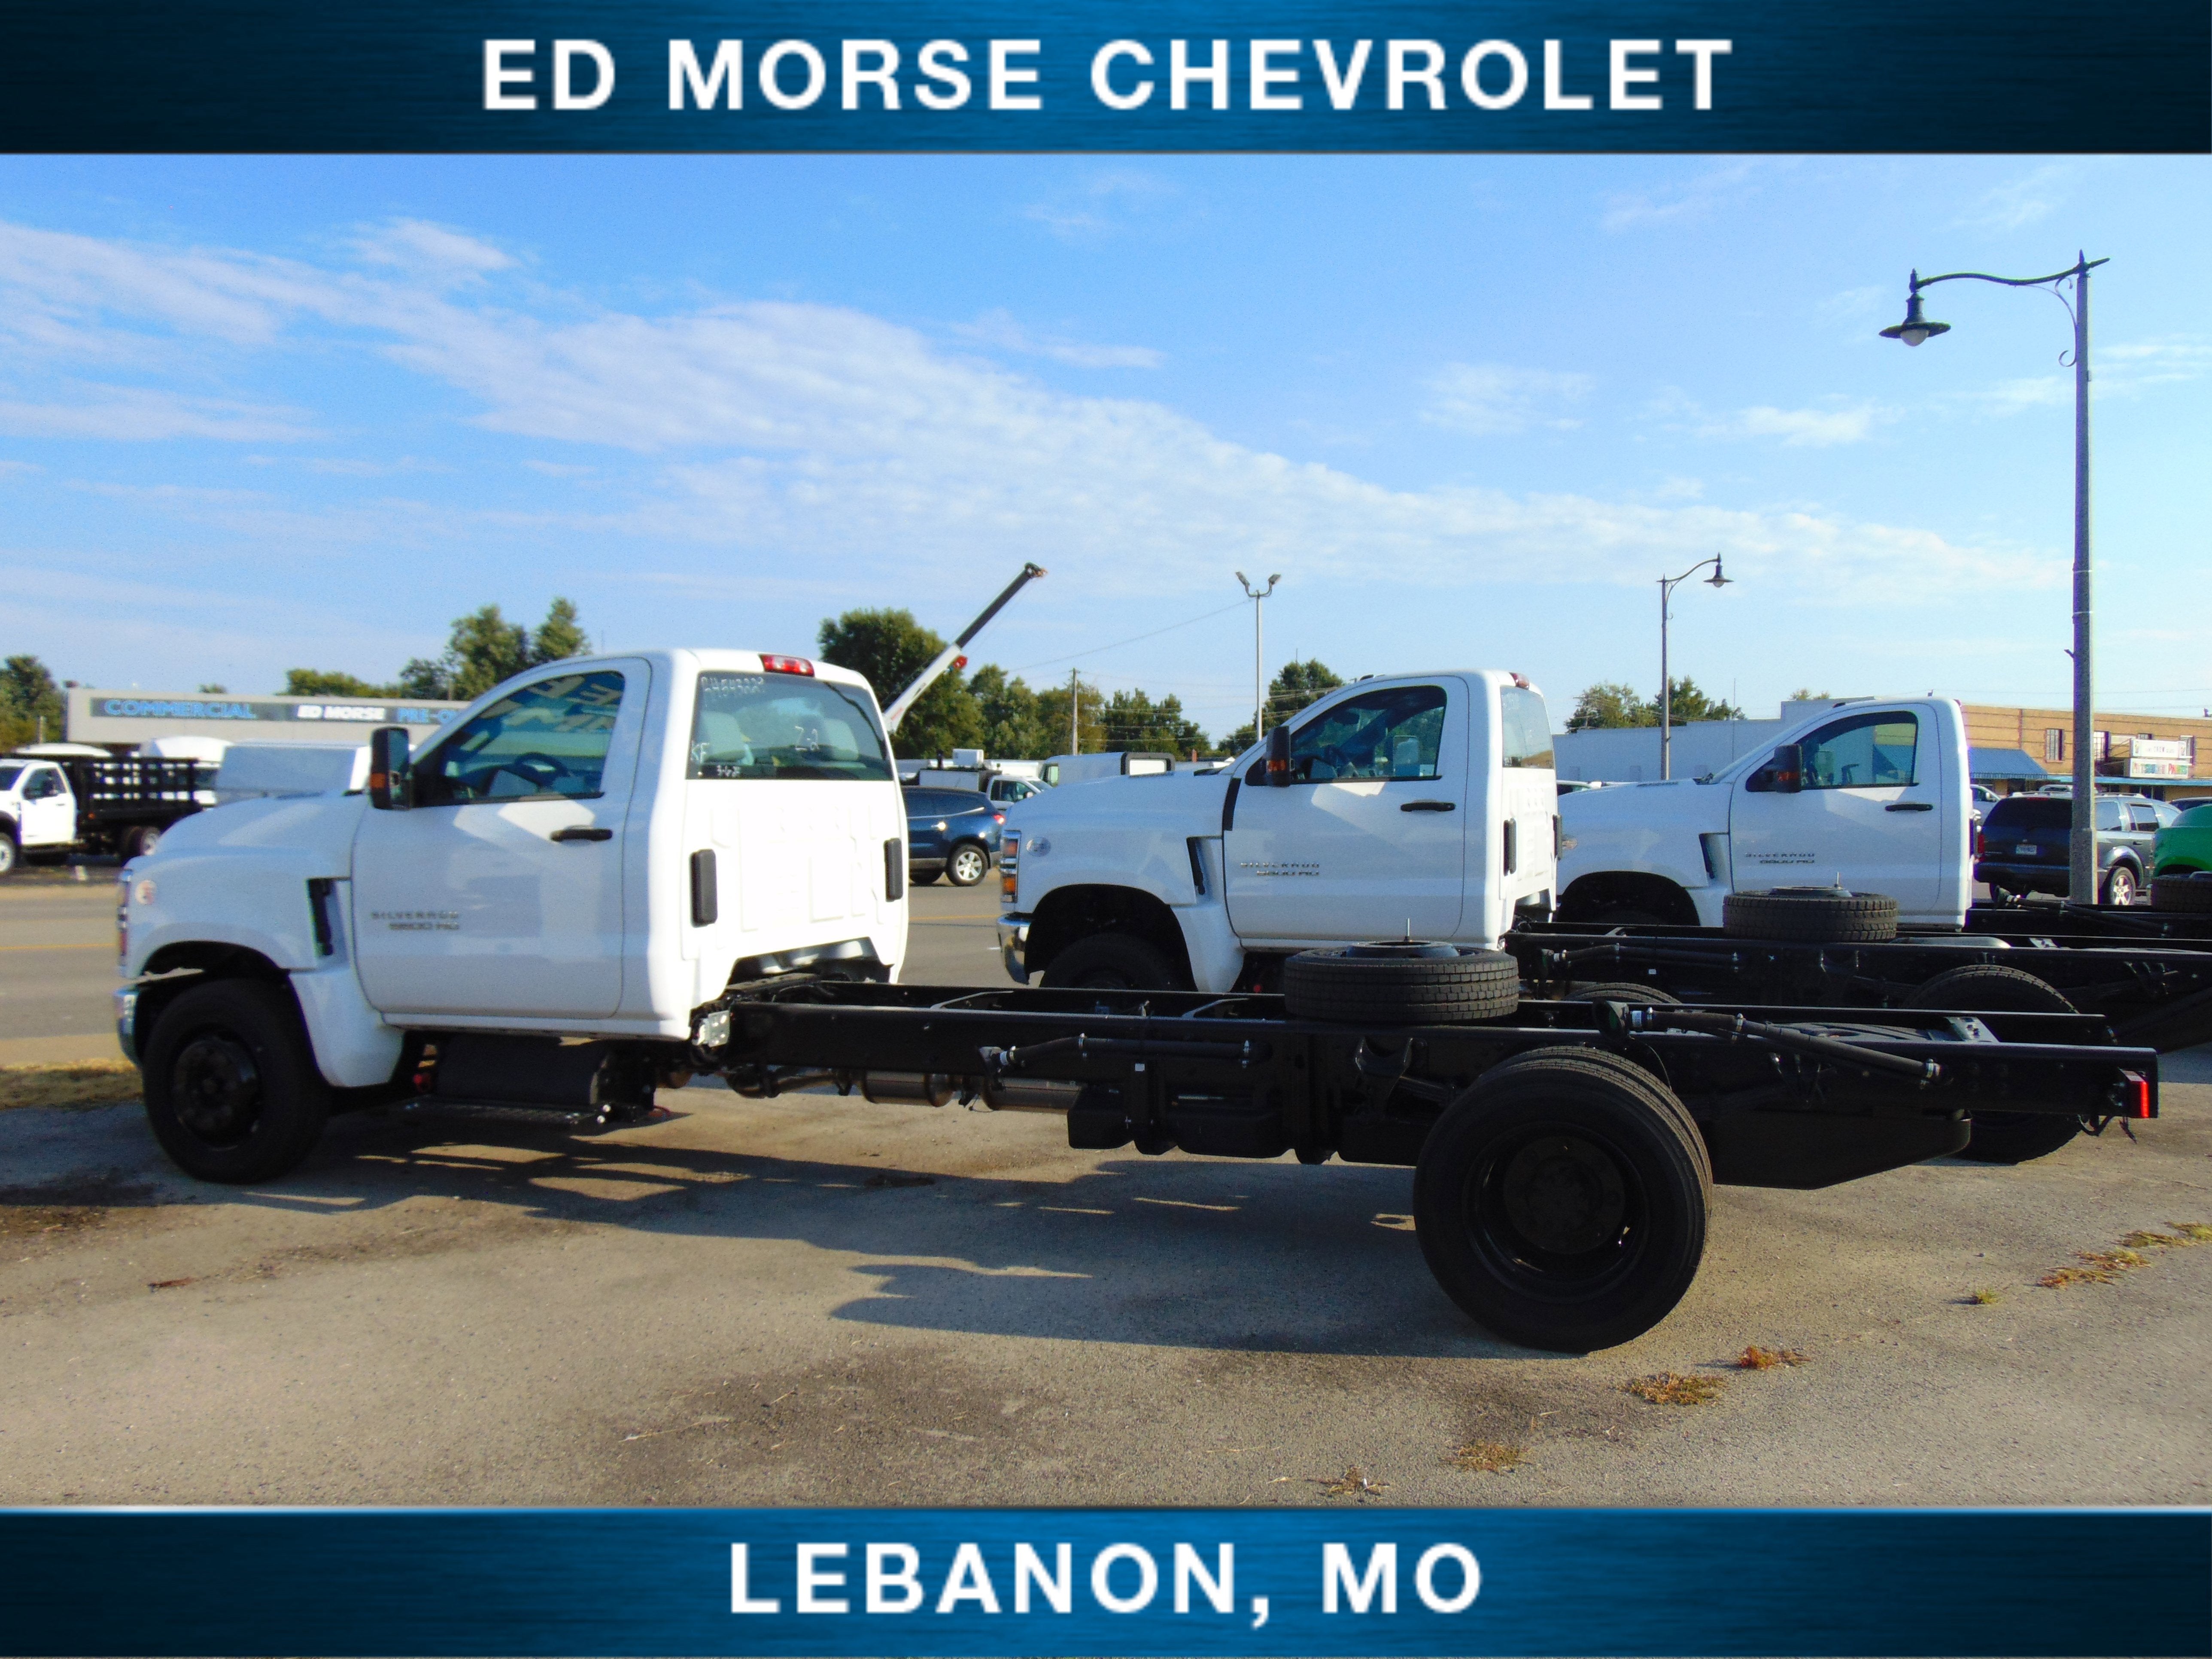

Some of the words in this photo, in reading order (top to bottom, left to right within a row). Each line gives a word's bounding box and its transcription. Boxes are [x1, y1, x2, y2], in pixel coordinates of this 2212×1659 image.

[104, 699, 258, 719] COMMERCIAL
[297, 704, 323, 719] ED
[324, 705, 386, 720] MORSE
